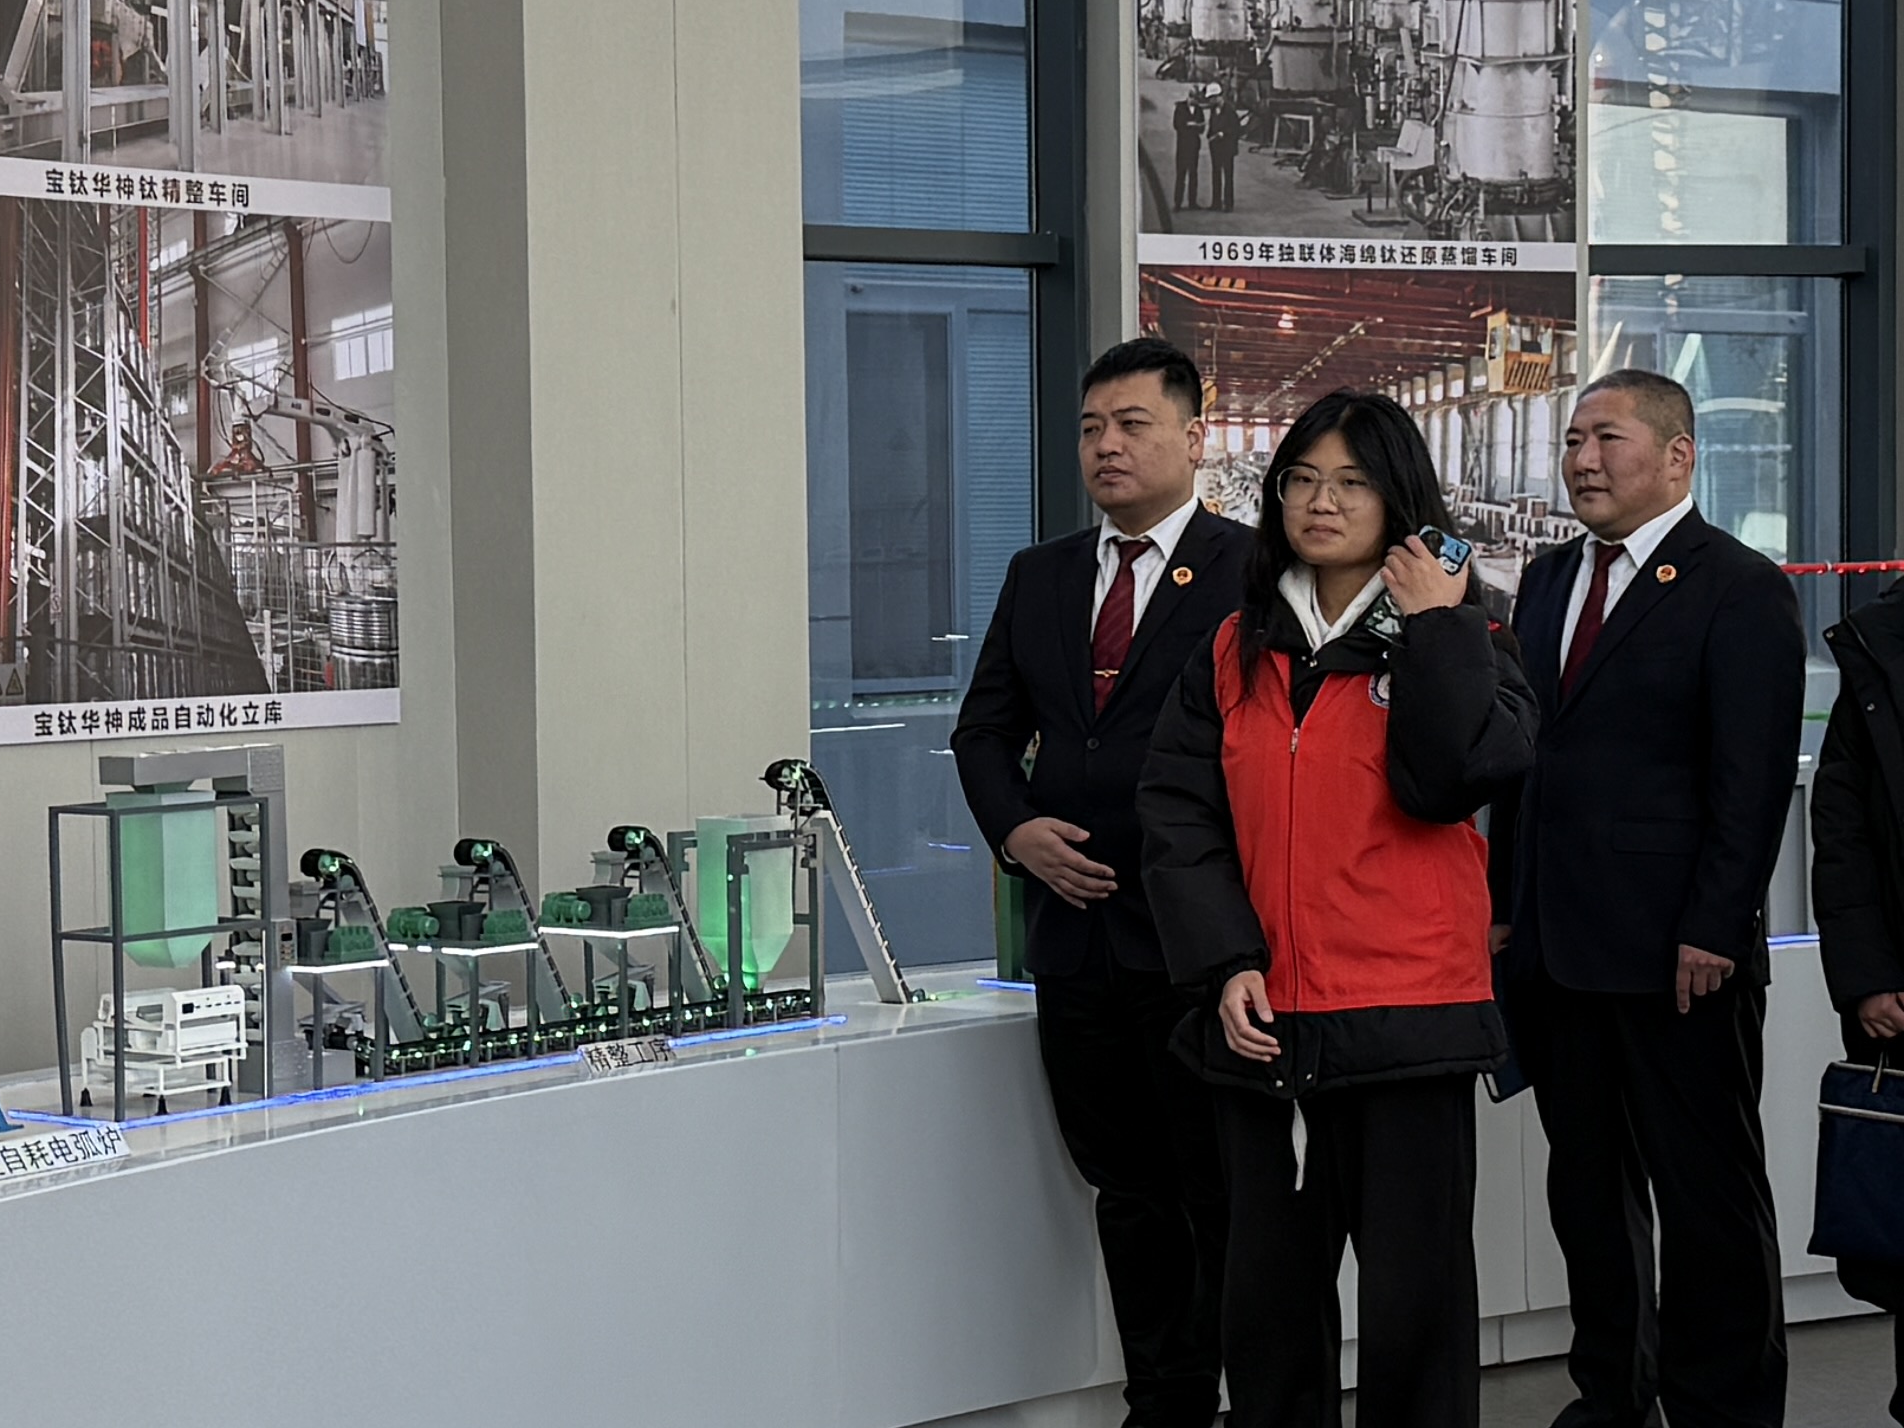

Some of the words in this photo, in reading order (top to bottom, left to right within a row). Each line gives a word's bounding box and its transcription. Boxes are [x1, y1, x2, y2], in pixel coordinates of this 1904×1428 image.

[45, 167, 250, 208] 宝钛华神钛精整车间
[1198, 241, 1519, 267] 1969年独联体海绵钛还原蒸馏车间
[33, 700, 282, 738] 宝钛华神成品自动化立库
